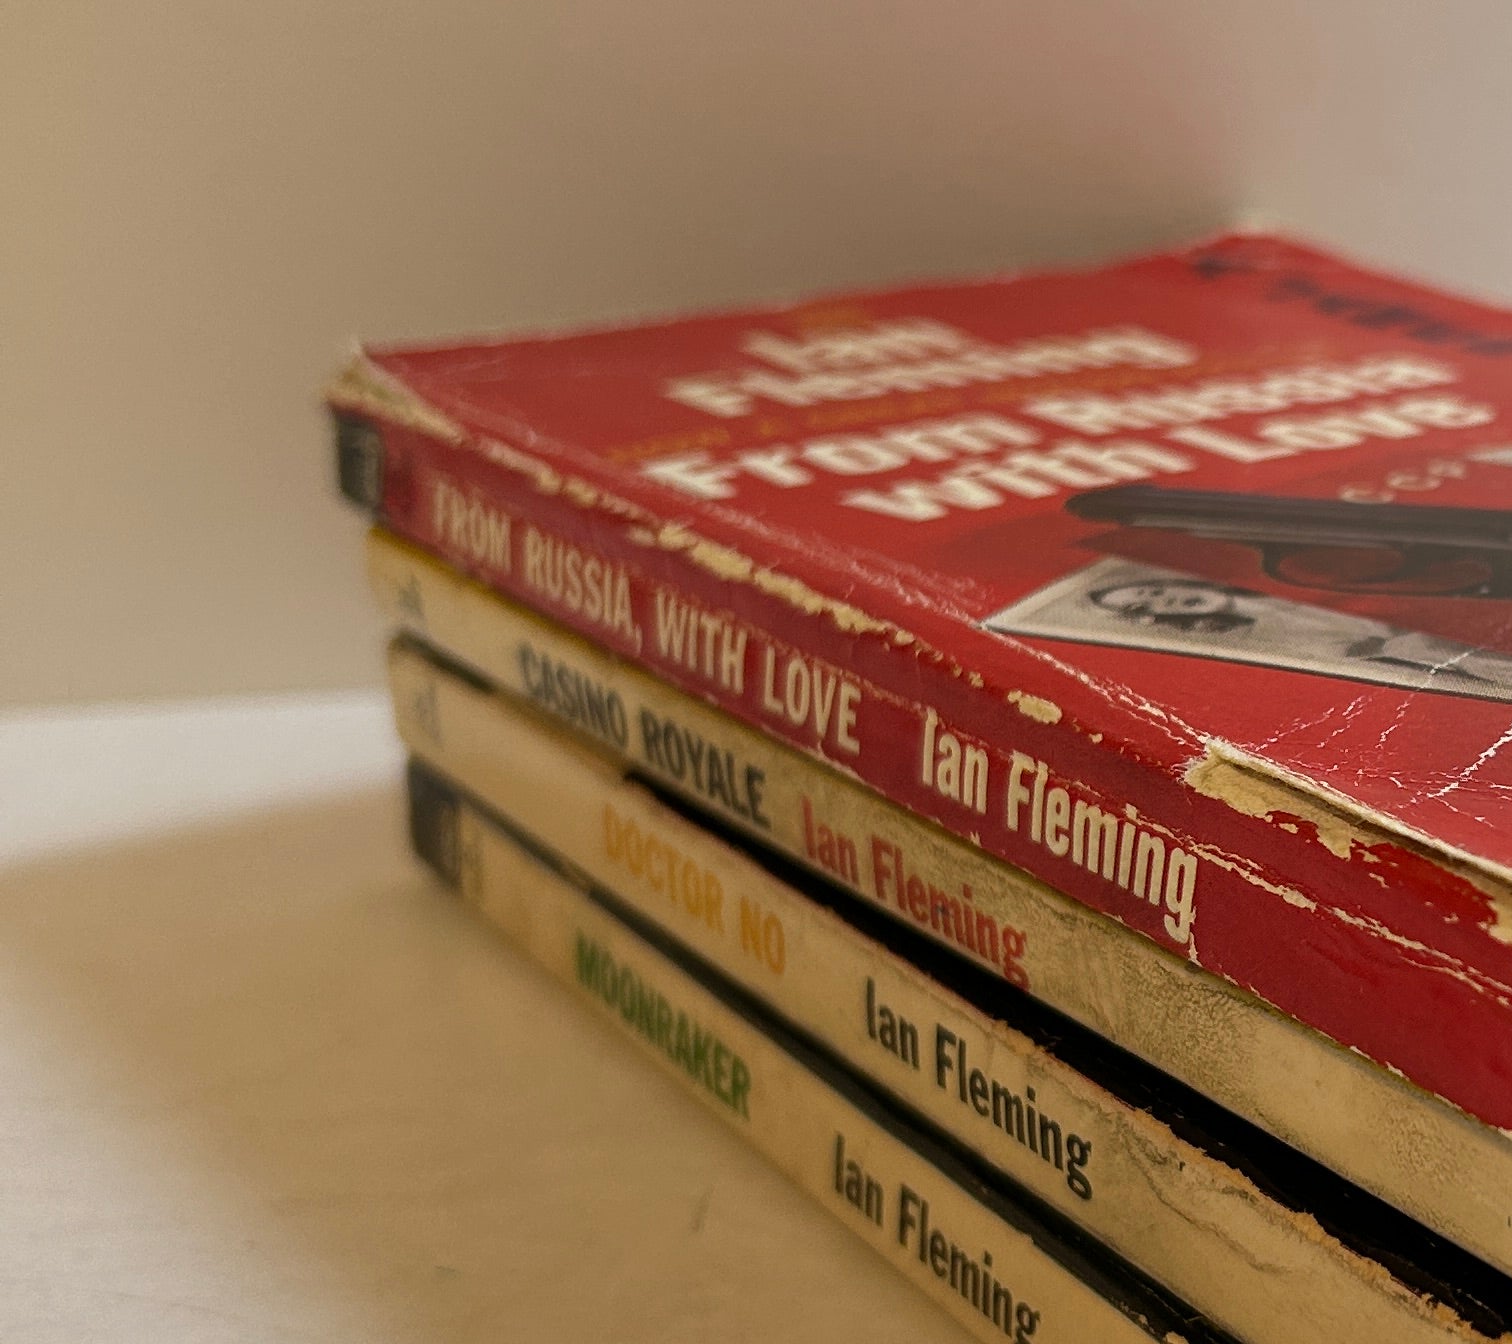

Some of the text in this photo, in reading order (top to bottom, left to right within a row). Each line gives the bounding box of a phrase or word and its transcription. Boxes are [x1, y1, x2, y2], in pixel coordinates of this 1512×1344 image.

[642, 412, 1040, 501] From
[1166, 397, 1495, 463] Love
[431, 482, 513, 576] FROM
[523, 531, 644, 654] RUSSIA,
[655, 590, 750, 698] WITH
[764, 641, 862, 756] LOVE
[921, 706, 988, 816] Ian
[1006, 751, 1199, 944] Fleming
[518, 642, 628, 751] CASINO
[640, 708, 772, 832] ROYALE
[802, 794, 860, 885] Ian
[872, 833, 1032, 994] Fleming
[572, 926, 752, 1124] MOONRAKER
[832, 1132, 885, 1228] Ian
[602, 803, 725, 929] DOCTOR
[739, 889, 788, 978] NO
[866, 977, 921, 1073] Ian
[934, 1020, 1093, 1201] Fleming
